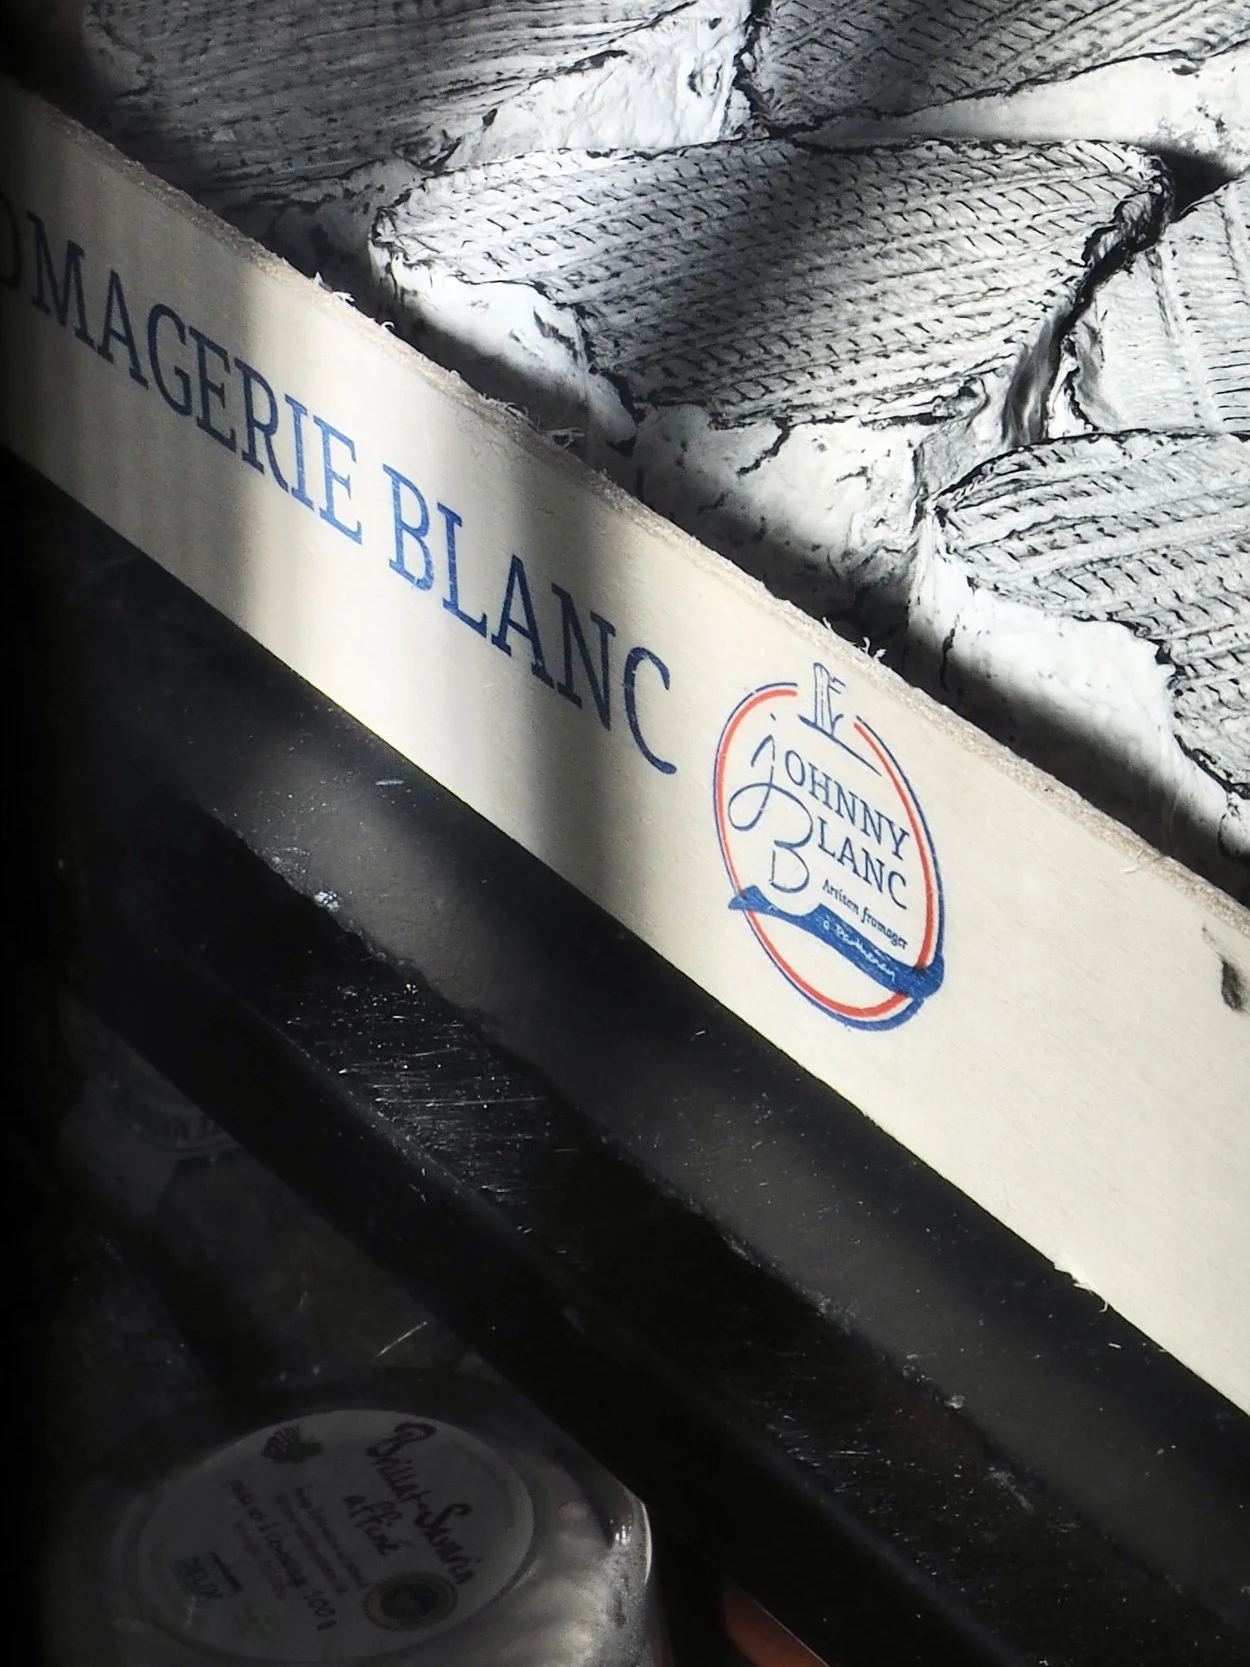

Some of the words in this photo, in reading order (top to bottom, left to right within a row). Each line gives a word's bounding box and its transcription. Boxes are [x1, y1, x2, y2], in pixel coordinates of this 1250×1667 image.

[381, 464, 677, 774] BLANC
[728, 732, 909, 862] JOHNNY
[768, 783, 909, 911] BLANC
